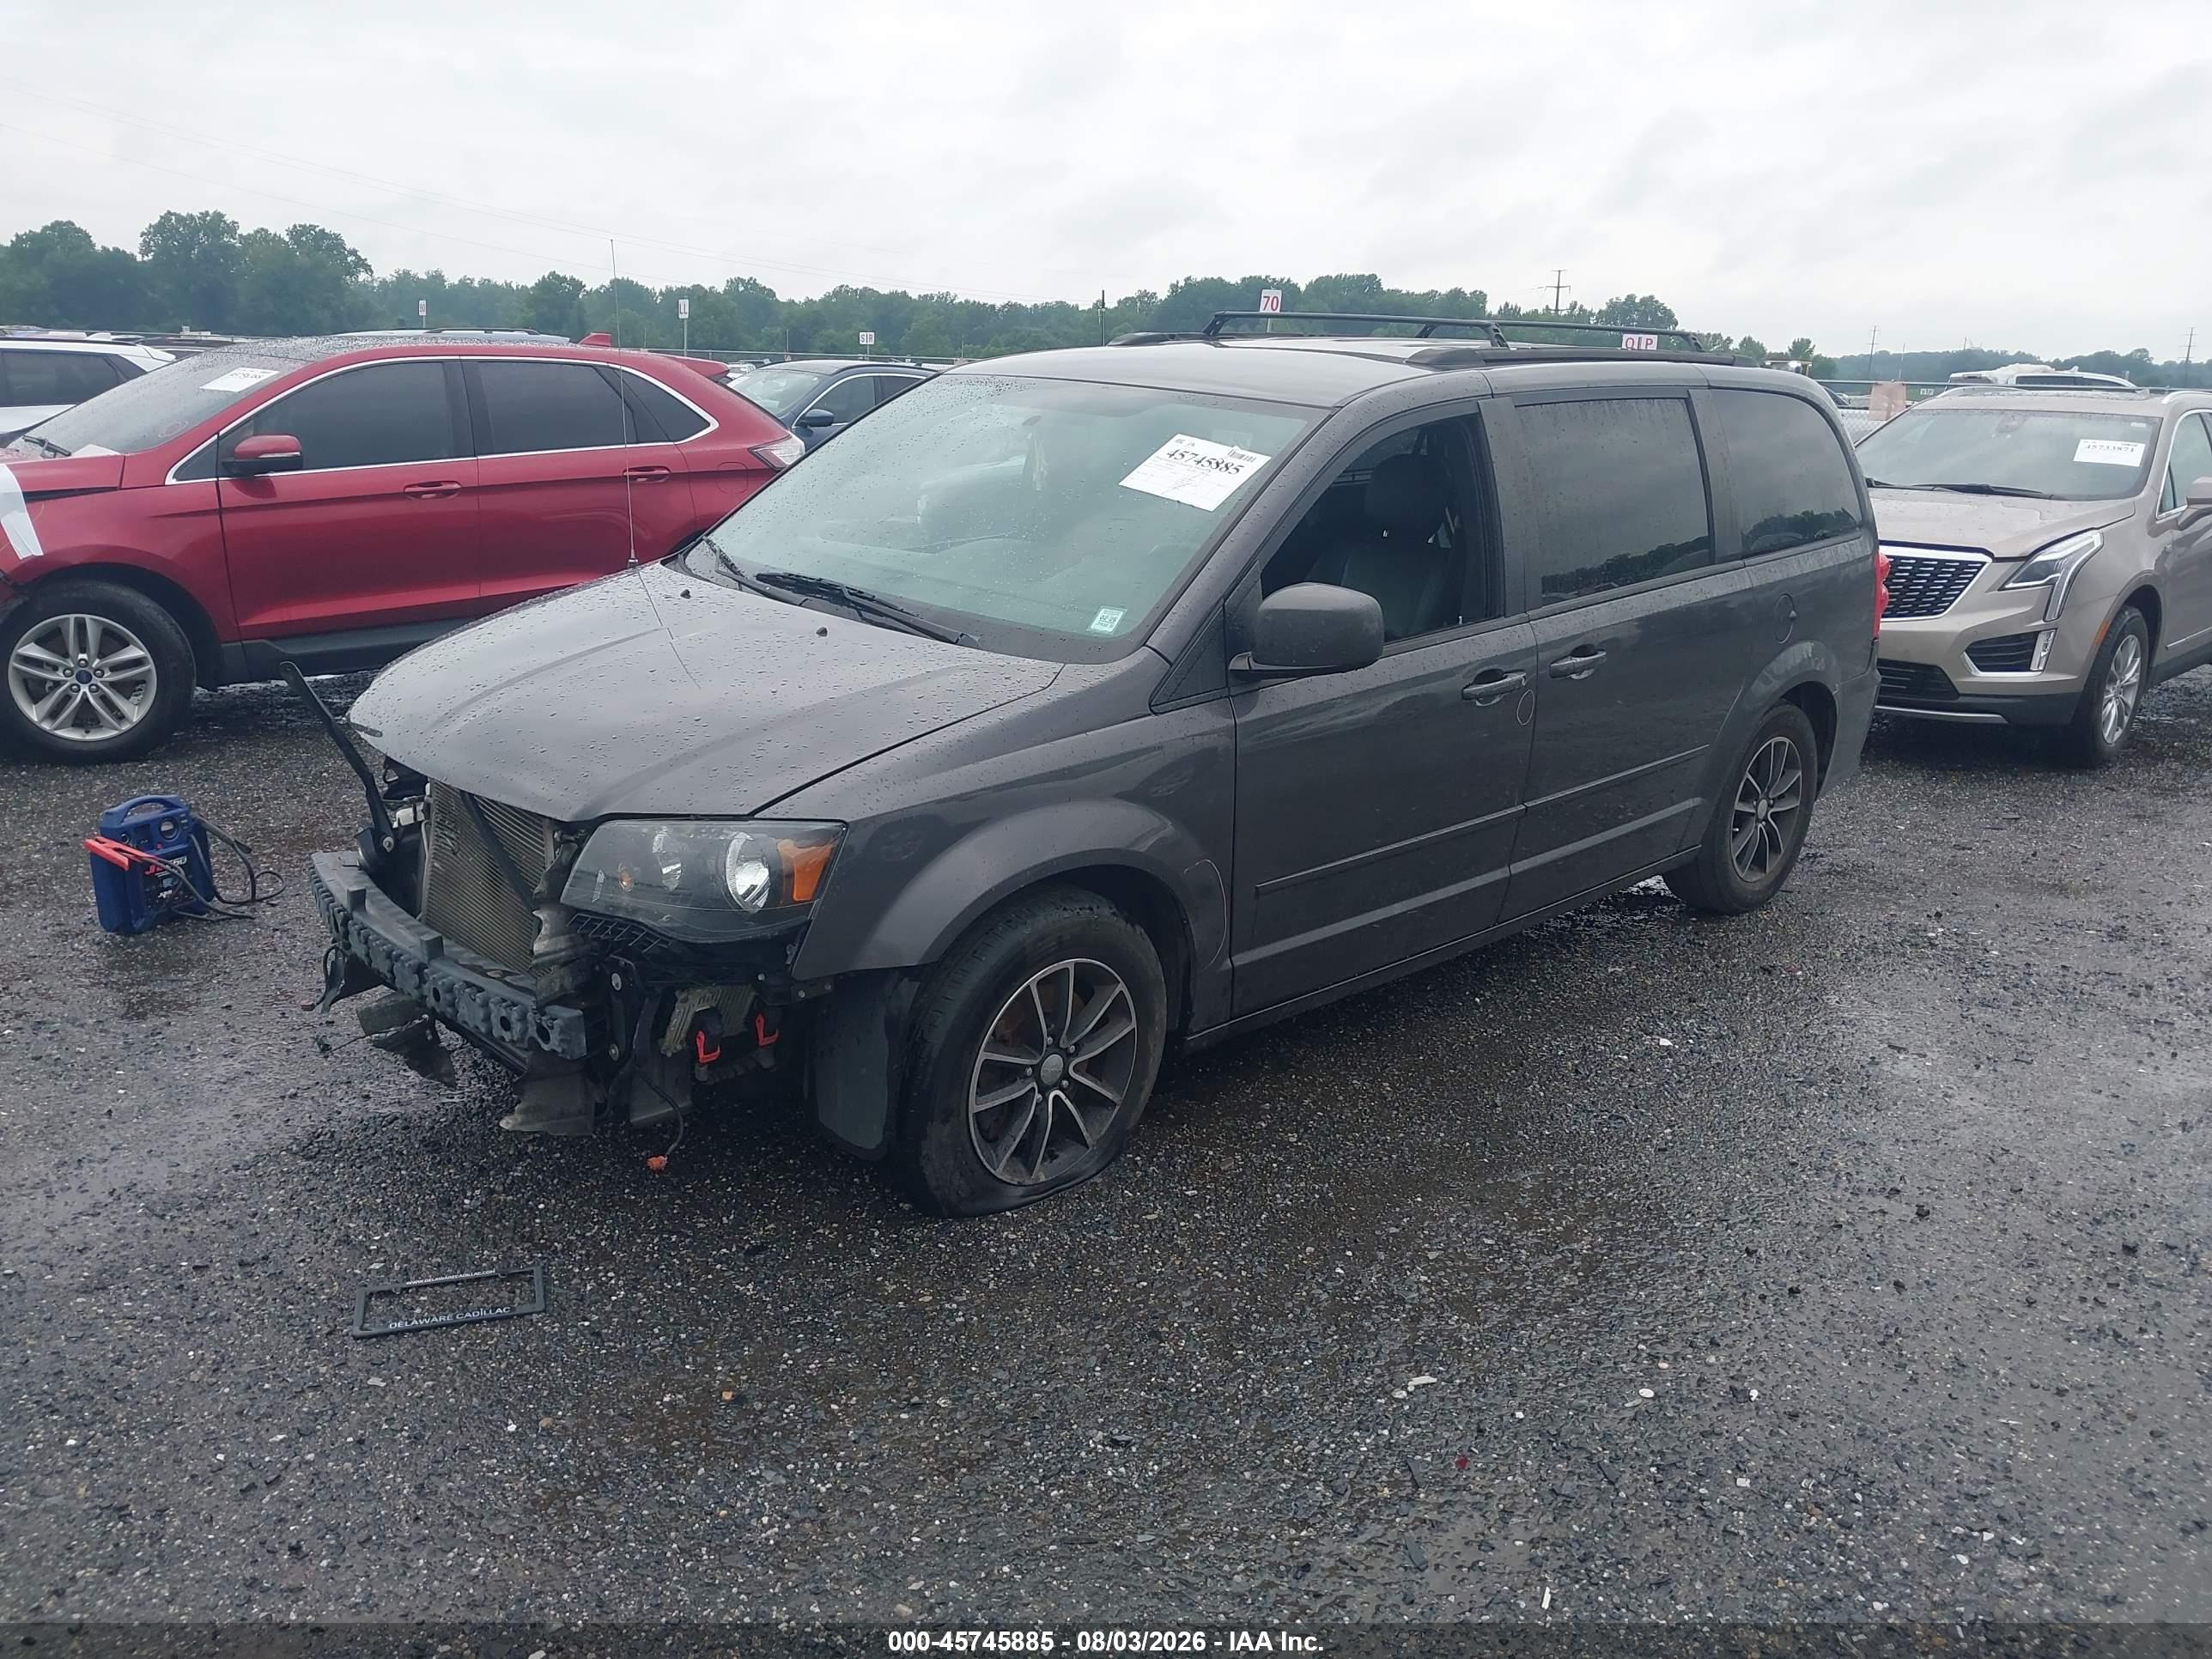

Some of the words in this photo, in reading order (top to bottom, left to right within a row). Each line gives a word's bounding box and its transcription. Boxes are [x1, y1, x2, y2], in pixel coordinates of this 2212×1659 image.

[1262, 295, 1279, 312] 70
[1166, 448, 1246, 475] 45745885
[388, 1314, 454, 1328] DELAWARE
[455, 1306, 512, 1319] CADILLAC
